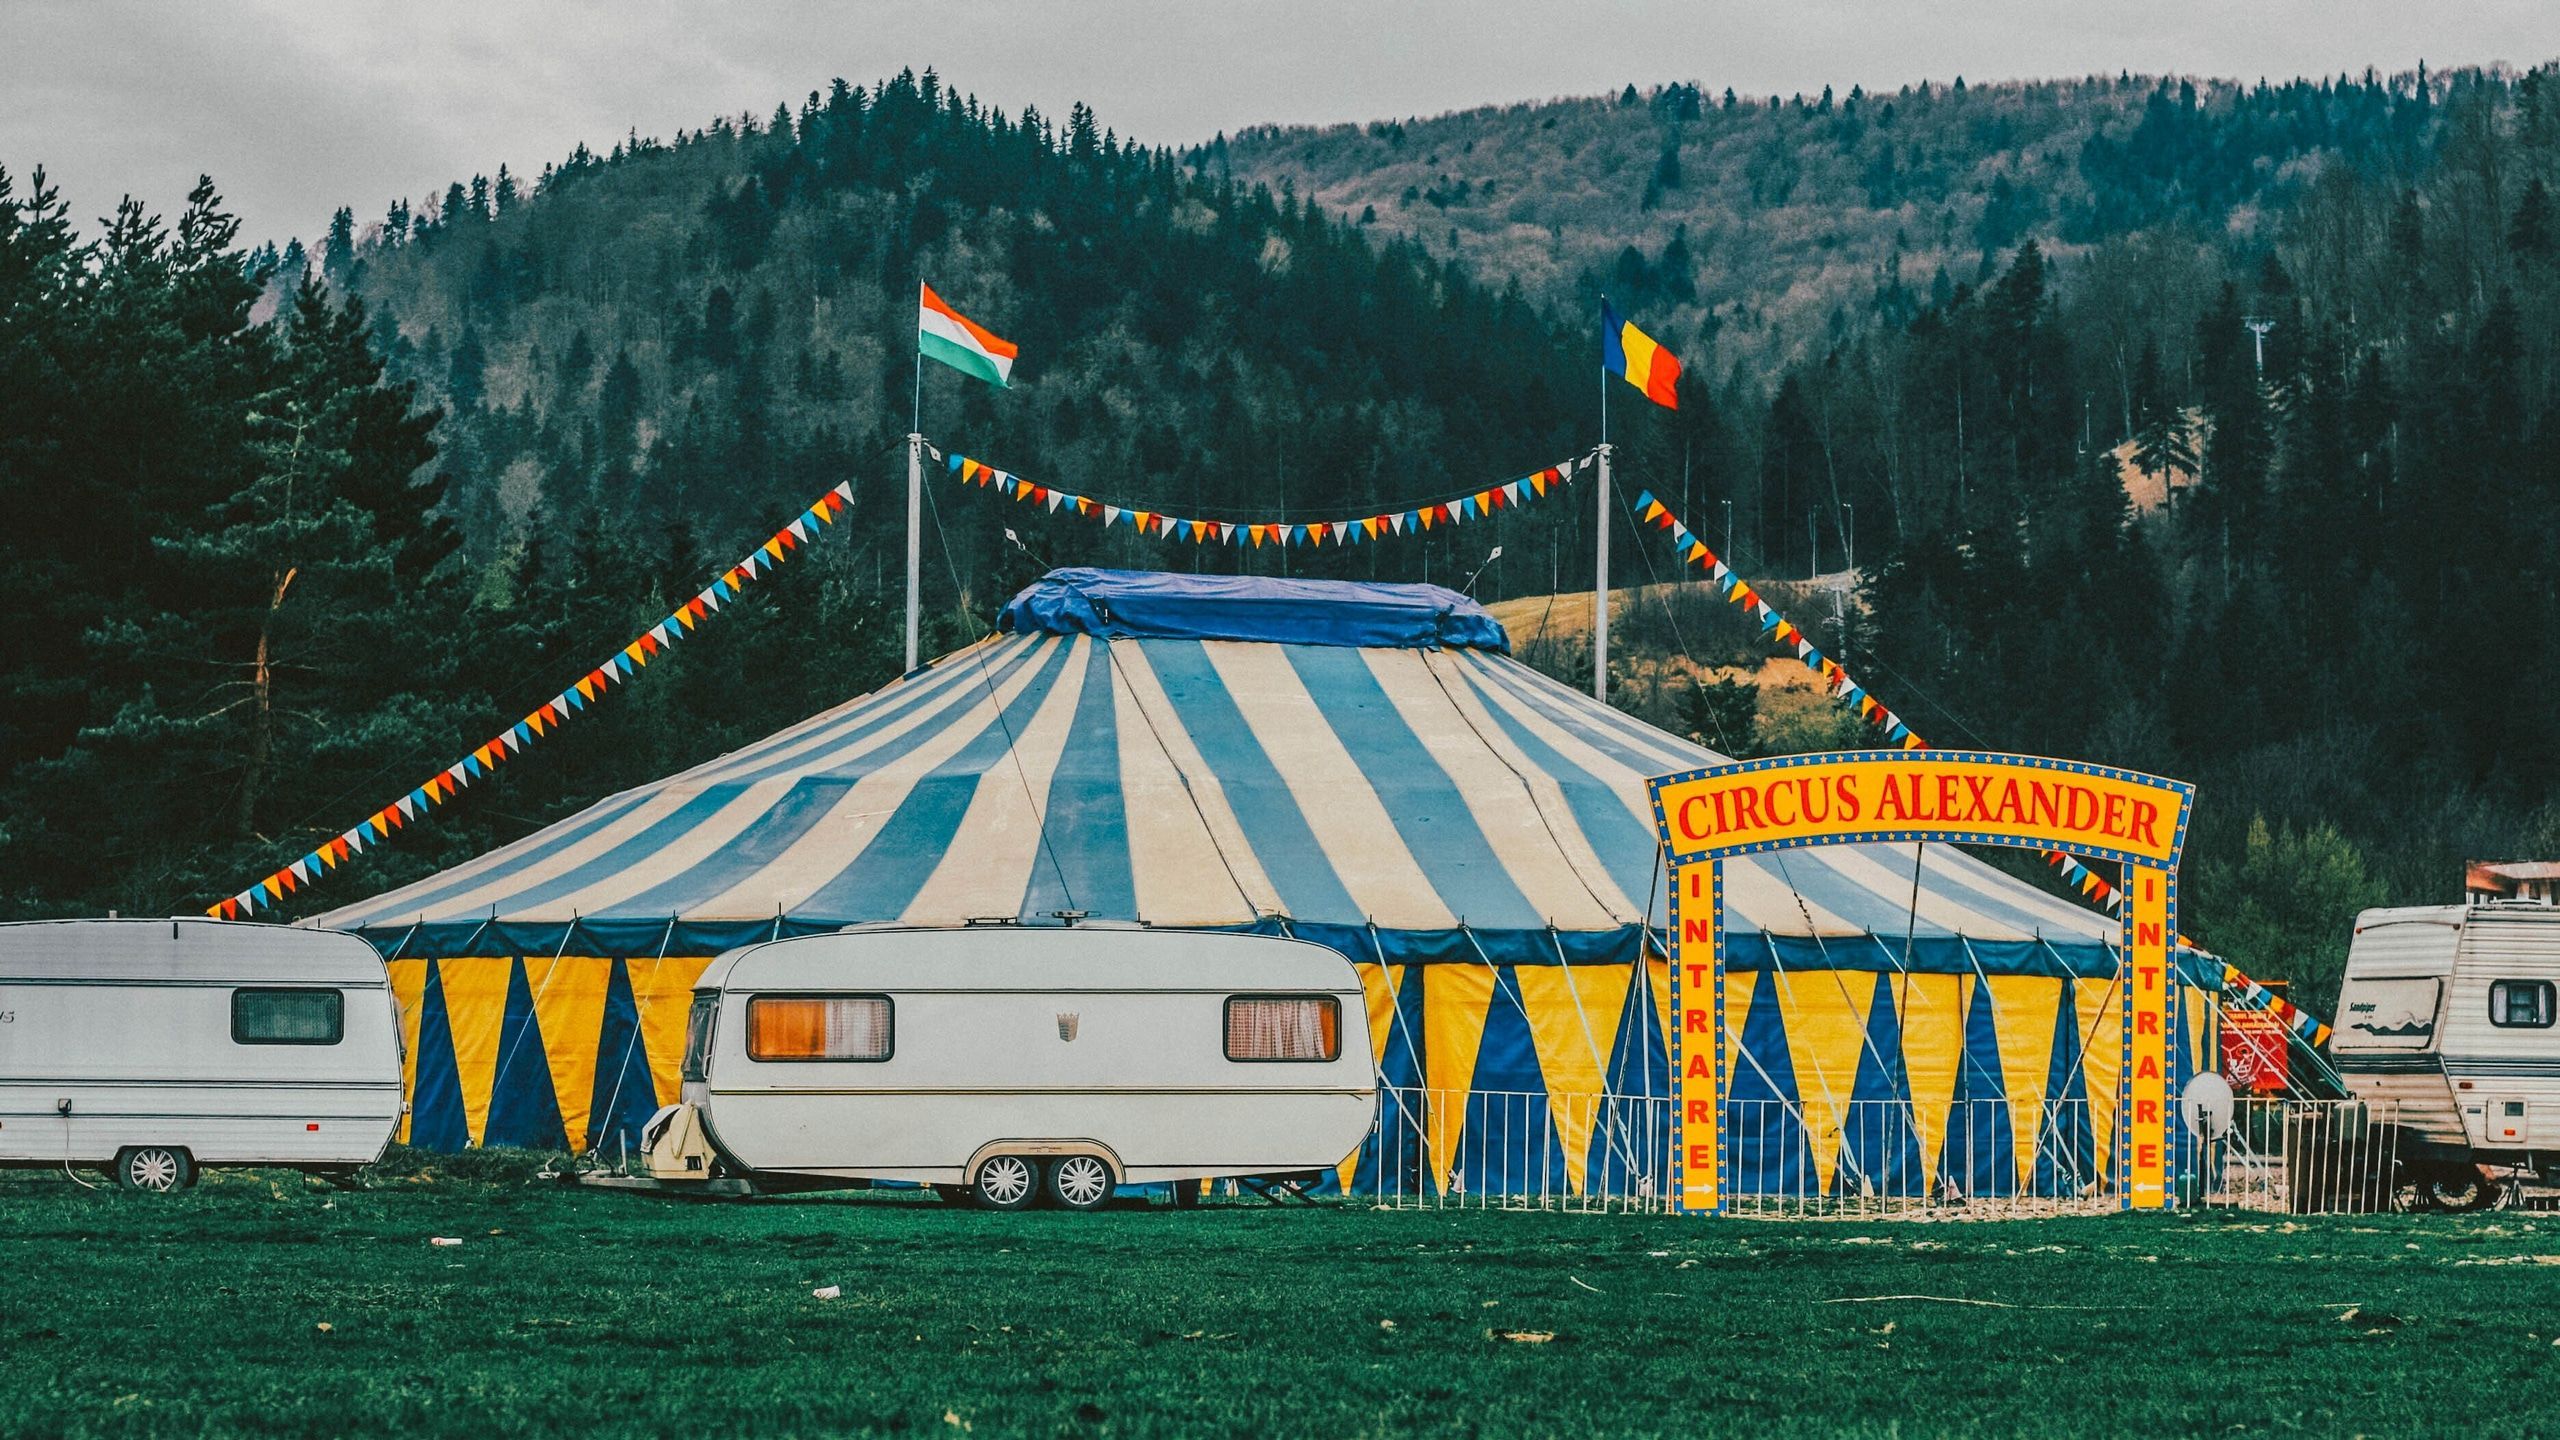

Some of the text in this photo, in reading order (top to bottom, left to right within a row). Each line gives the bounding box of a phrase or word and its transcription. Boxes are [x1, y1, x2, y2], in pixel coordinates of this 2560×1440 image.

[1678, 773, 2161, 848] CIRCUS ALEXANDER
[1685, 873, 1711, 1170] INTRARE
[2136, 878, 2161, 1169] INTRARE
